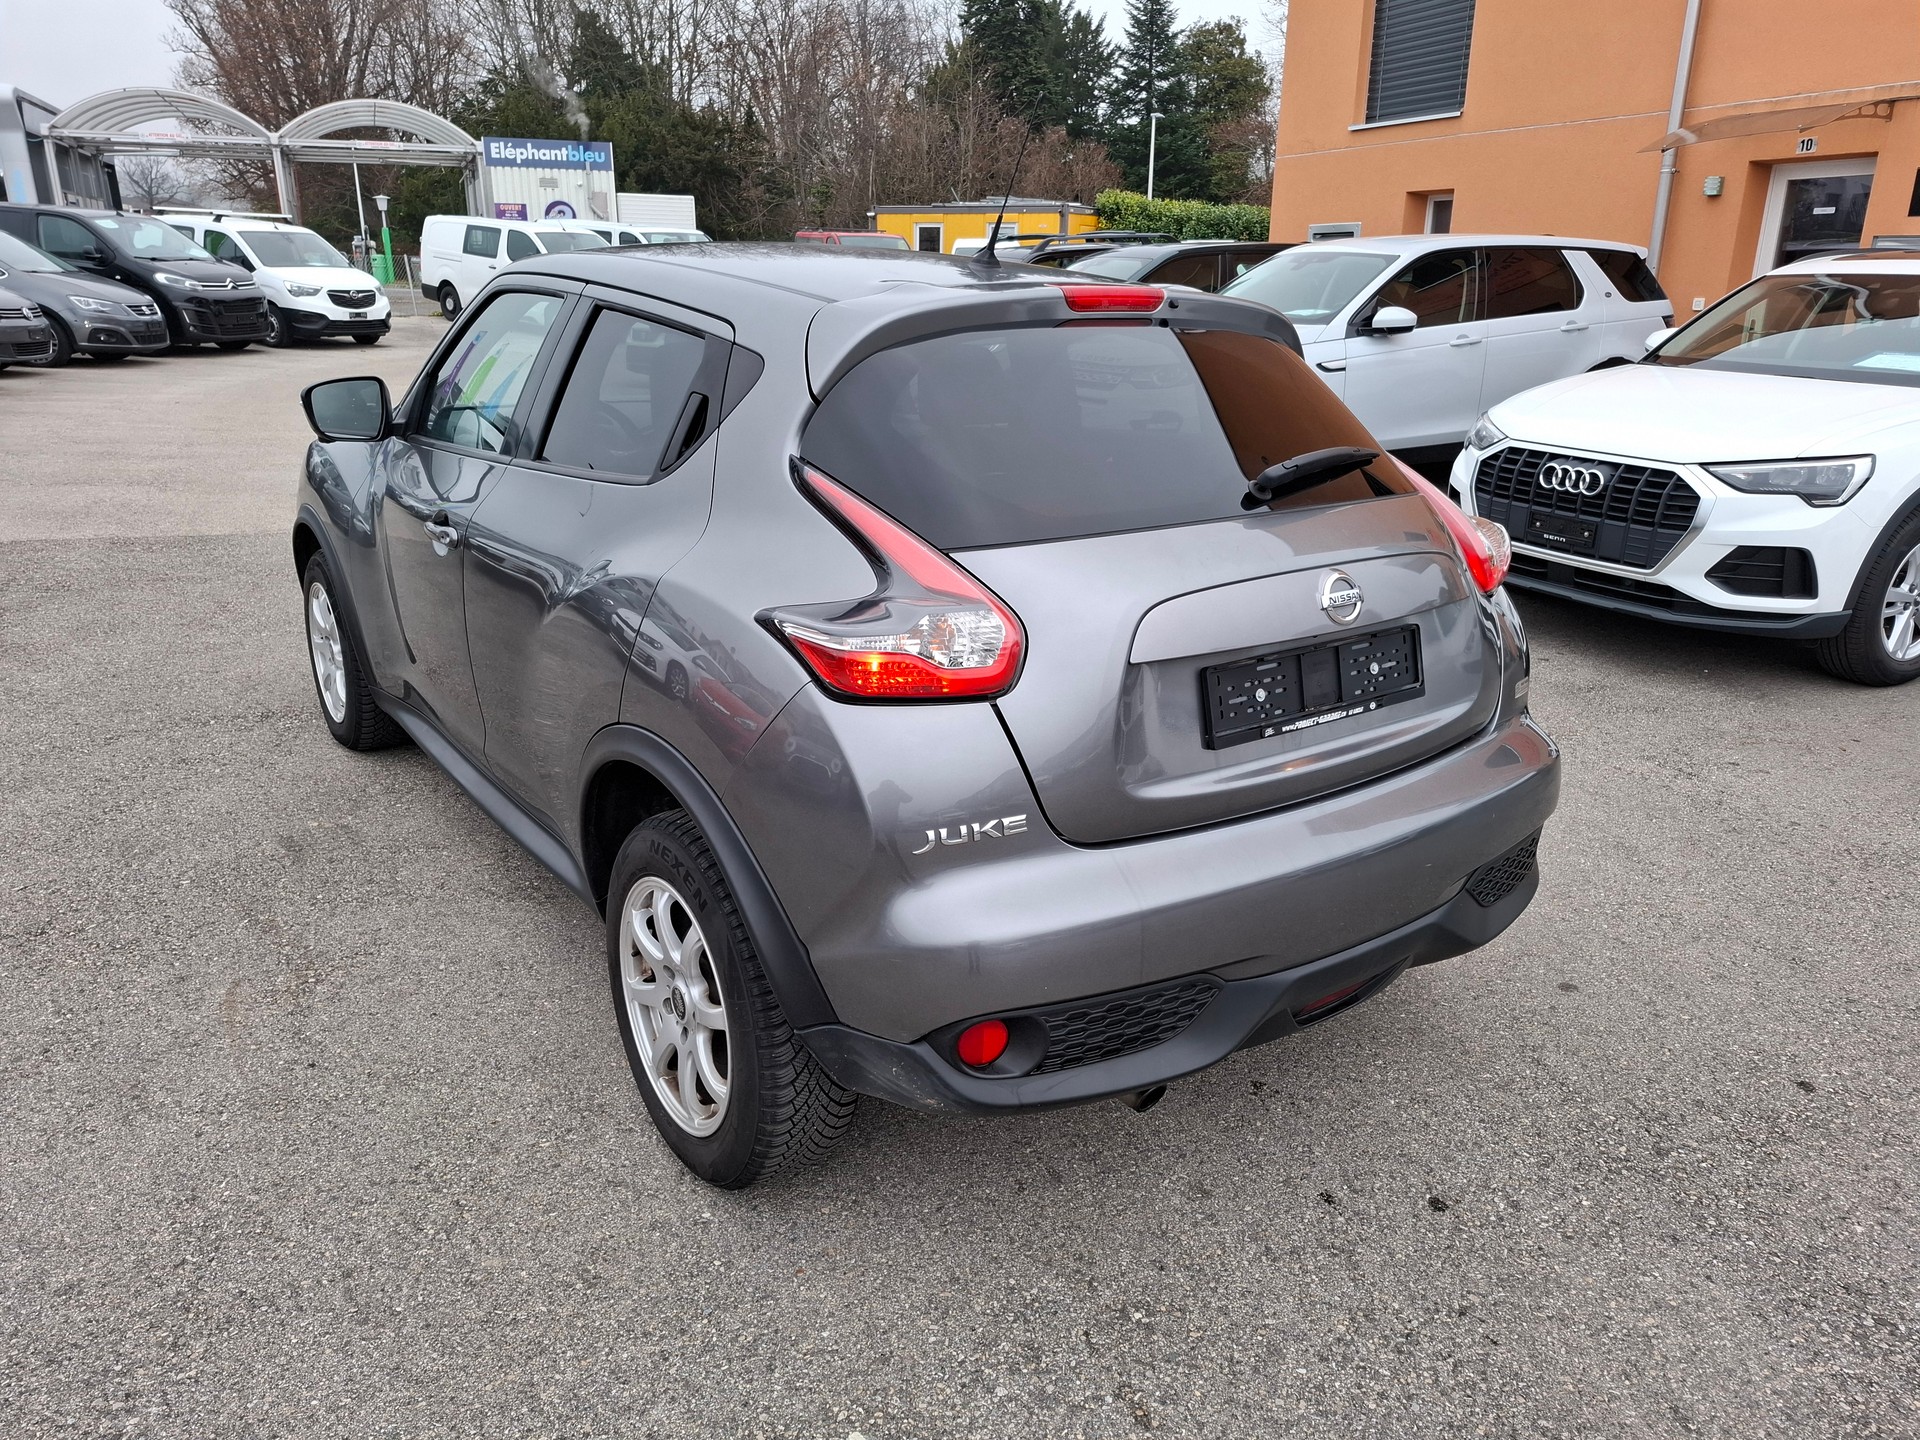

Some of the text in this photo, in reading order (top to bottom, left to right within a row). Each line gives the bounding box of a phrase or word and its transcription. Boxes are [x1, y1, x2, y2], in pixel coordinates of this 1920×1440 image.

[1800, 138, 1813, 152] 10
[1329, 590, 1362, 604] NISSAN
[912, 814, 1028, 855] JUKE
[649, 839, 708, 913] NEXEN
